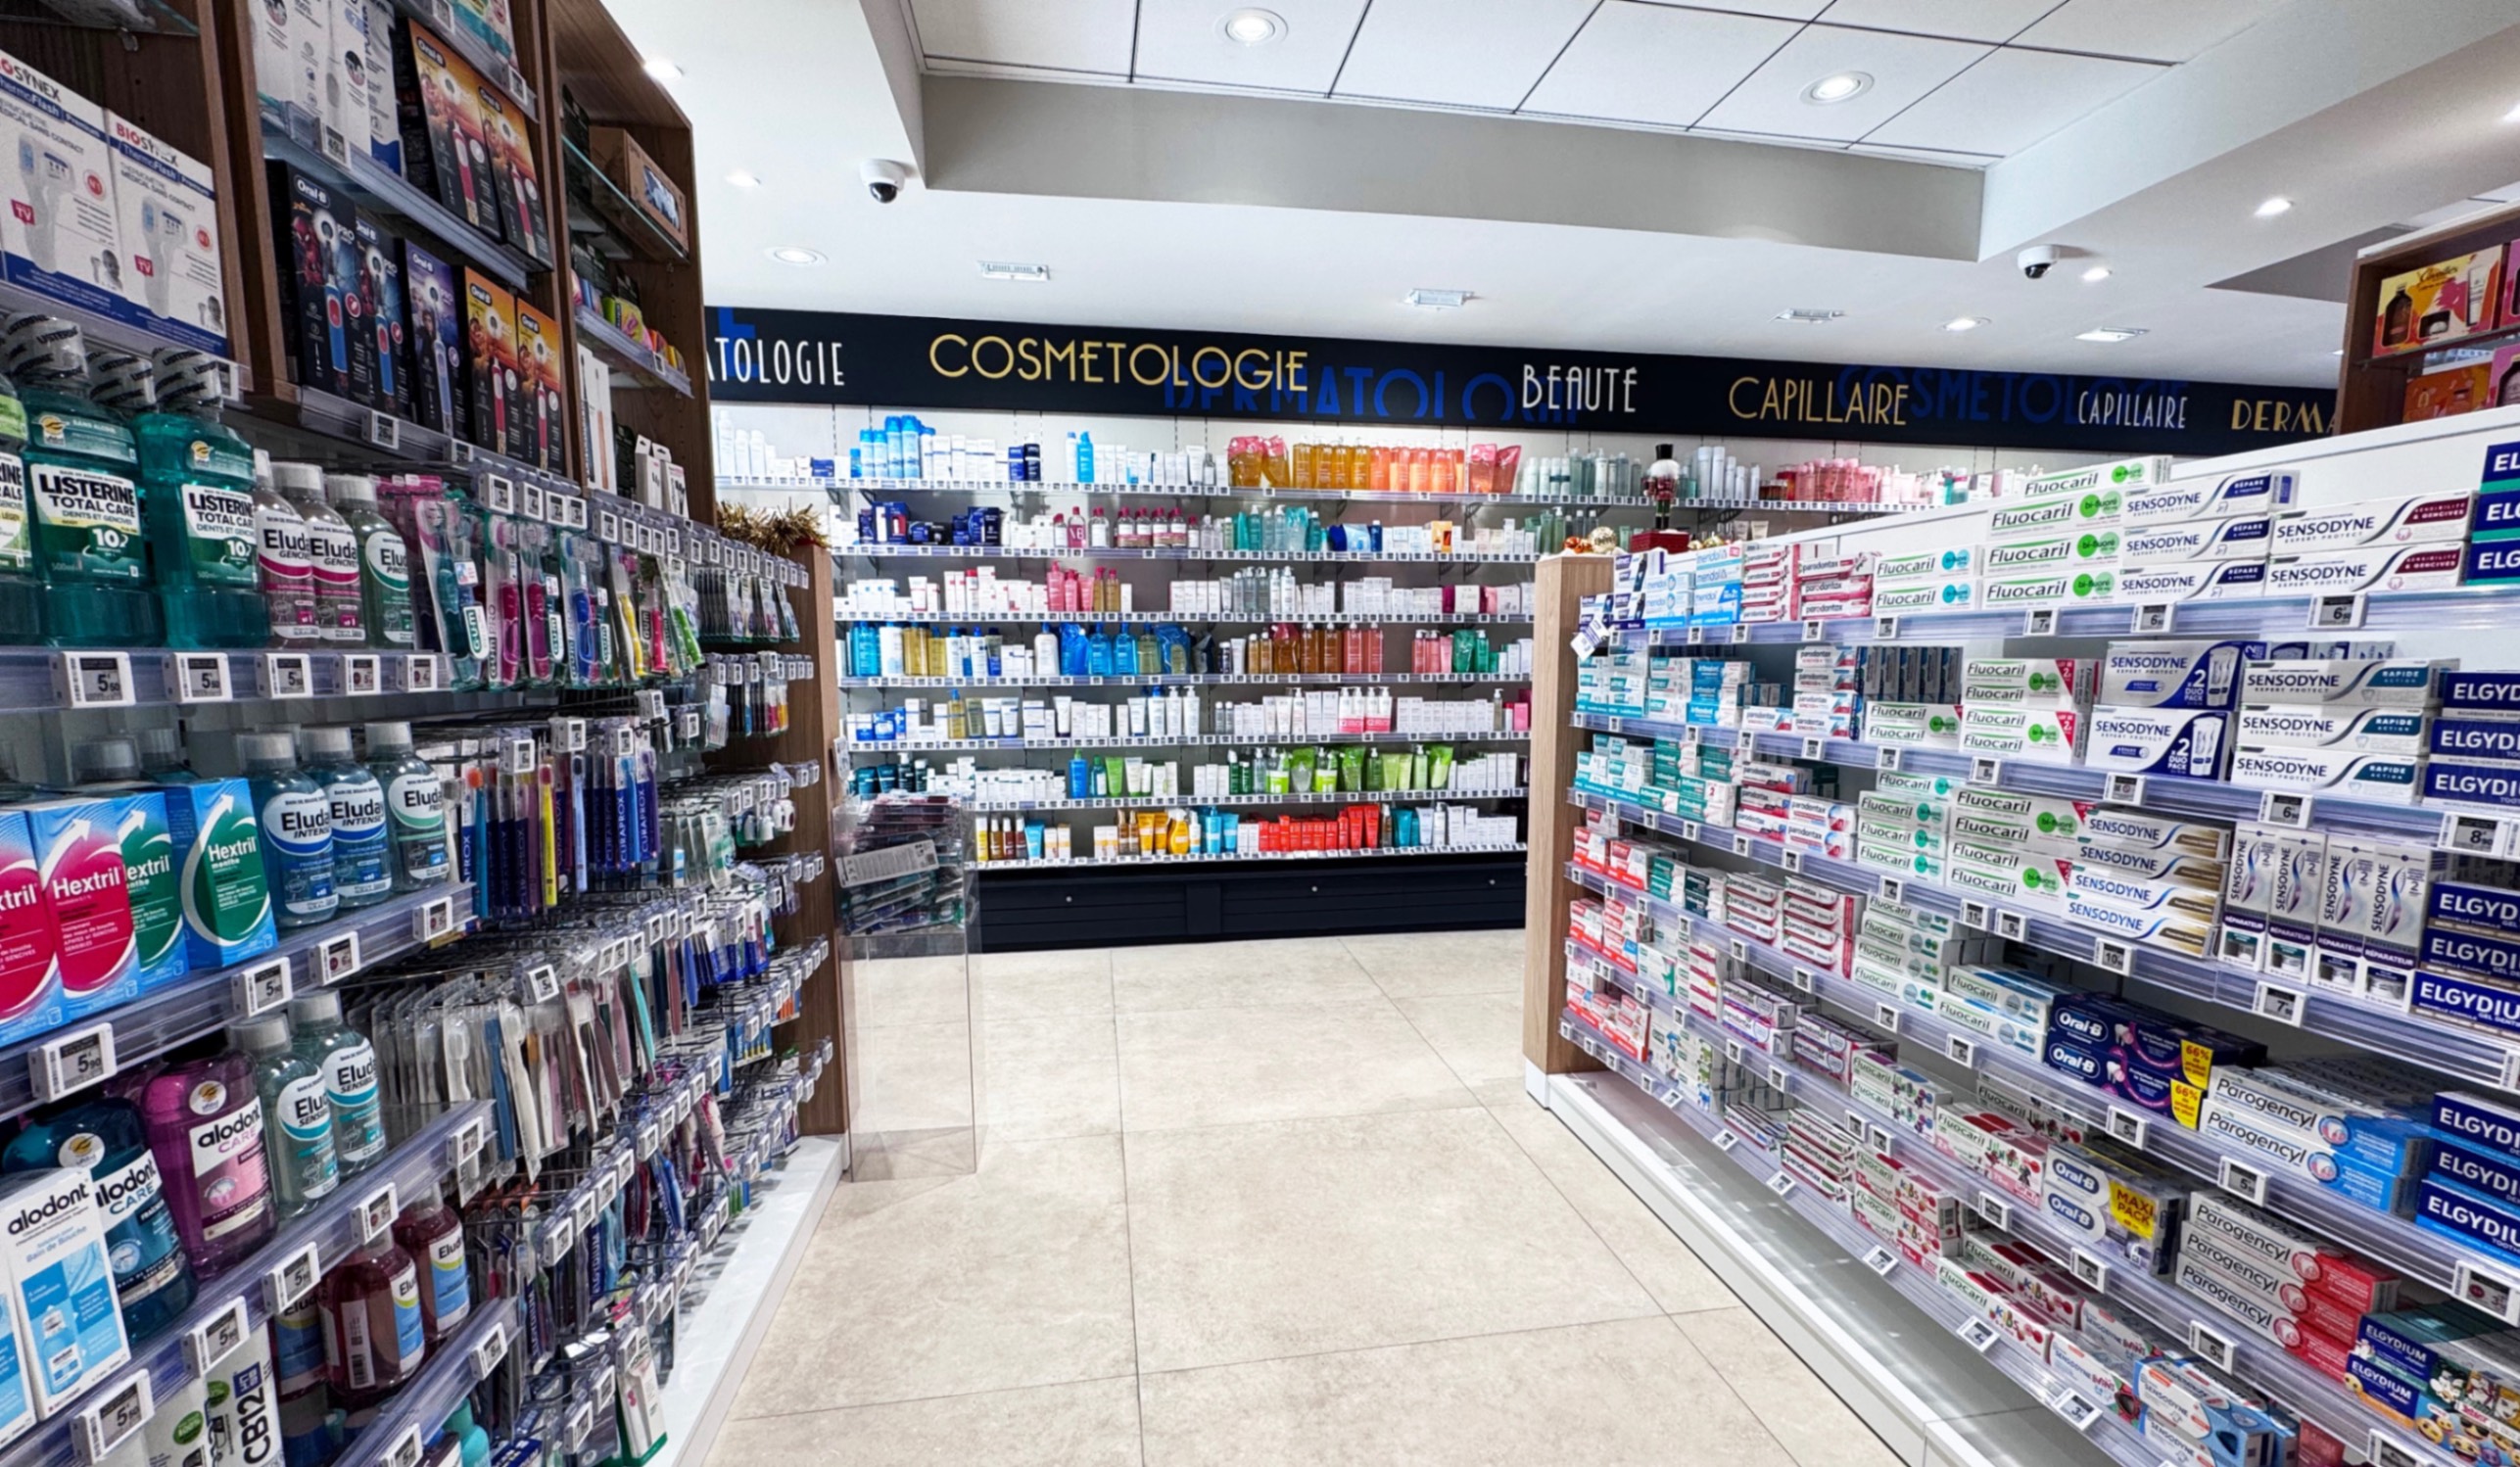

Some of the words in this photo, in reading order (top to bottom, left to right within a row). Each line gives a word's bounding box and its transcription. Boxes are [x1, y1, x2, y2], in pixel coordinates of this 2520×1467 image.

[297, 179, 328, 204] Oral-B
[929, 334, 1308, 392] COSMETOLOGIE
[1523, 363, 1638, 413] BEAUTÉ
[1729, 377, 1908, 425] CAPILLAIRE
[2078, 391, 2188, 429] CAPILLAIRE
[39, 472, 135, 507] LISTERINE
[2024, 471, 2099, 497] Fluocaril
[50, 494, 106, 515] TOTAL
[107, 502, 135, 519] CARE
[62, 509, 91, 521] DENTS
[92, 512, 102, 521] ET
[1991, 501, 2074, 529] Fluocaril
[2127, 493, 2202, 514] SENSODYNE
[197, 511, 235, 526] TOTAL
[2276, 516, 2375, 540] SENSODYNE
[1988, 542, 2071, 565] Fluocaril
[2126, 535, 2201, 553] SENSODYNE
[1877, 556, 1936, 577] Fluocaril
[2270, 564, 2368, 583] SENSODYNE
[1876, 588, 1936, 606] Fluocaril
[1986, 580, 2068, 600] Fluocaril
[2121, 576, 2196, 592] SENSODYNE
[1967, 662, 2025, 678] Fluocaril
[2111, 656, 2188, 670] SENSODYNE
[2247, 673, 2340, 688] SENSODYNE
[2382, 670, 2419, 679] RAPIDE
[1965, 686, 2023, 702] Fluocaril
[1870, 705, 1926, 721] Fluocaril
[1966, 710, 2025, 727] Fluocaril
[2243, 716, 2335, 734] SENSODYNE
[2376, 717, 2413, 727] RAPIDE
[1870, 726, 1926, 741] Fluocaril
[2095, 720, 2171, 736] SENSODYNE
[1964, 735, 2023, 752] Fluocaril
[2236, 757, 2328, 778] SENSODYNE
[2369, 764, 2405, 775] RAPIDE
[1878, 774, 1931, 791] Fluocaril
[2435, 774, 2520, 797] ELGYDI
[1861, 797, 1914, 818] Fluocaril
[1957, 790, 2032, 814] Fluocaril
[1861, 822, 1911, 843] Fluocaril
[1955, 817, 2029, 841] Fluocaril
[2088, 818, 2161, 841] SENSODYNE
[208, 836, 258, 863] Hextril
[1860, 845, 1911, 869] Fluocaril
[1952, 842, 2020, 868] Fluocaril
[2080, 846, 2159, 872] SENSODYNE
[212, 858, 240, 870] menthe
[2230, 838, 2248, 900] SENSODYNE
[53, 866, 121, 899] Hextril
[1951, 868, 2018, 895] Fluocaril
[2075, 874, 2152, 902] SENSODYNE
[2275, 846, 2292, 911] SENSODYNE
[2324, 854, 2342, 921] SENSODYNE
[1869, 895, 1912, 918] Fluocaril
[2371, 863, 2390, 932] SENSODYNE
[2068, 901, 2144, 931] SENSODYNE
[1864, 920, 1905, 942] Fluocaril
[1858, 940, 1902, 966] Fluocaril
[2431, 937, 2520, 970] ELGYDI
[1855, 967, 1898, 991] Fluocaril
[1951, 974, 1998, 1002] Fluocaril
[1939, 1001, 1990, 1030] Fluocaril
[2059, 1012, 2104, 1038] Oral-B
[2052, 1047, 2096, 1075] Oral-B
[1978, 1086, 2026, 1117] Fluocaril
[2216, 1077, 2318, 1131] Parogencyl
[218, 1126, 257, 1154] CARE
[1938, 1112, 1985, 1146] Fluocaril
[2208, 1111, 2307, 1165] Parogencyl
[2056, 1162, 2097, 1191] Oral-B
[2439, 1152, 2520, 1197] ELGYDI
[8, 1182, 89, 1236] alodont
[110, 1183, 155, 1215] CARE
[2050, 1197, 2093, 1226] Oral-B
[2116, 1188, 2155, 1214] MAXI
[2116, 1203, 2151, 1225] PACK
[2196, 1204, 2291, 1263] Parogencyl
[1965, 1240, 2015, 1279] Fluocaril
[2187, 1233, 2280, 1294] Parogencyl
[1939, 1265, 1988, 1306] Fluocaril
[2182, 1263, 2273, 1327] Parogencyl
[2366, 1324, 2429, 1362] ELGYDIUM
[2352, 1360, 2413, 1400] ELGYDIUM
[237, 1386, 270, 1465] CB12
